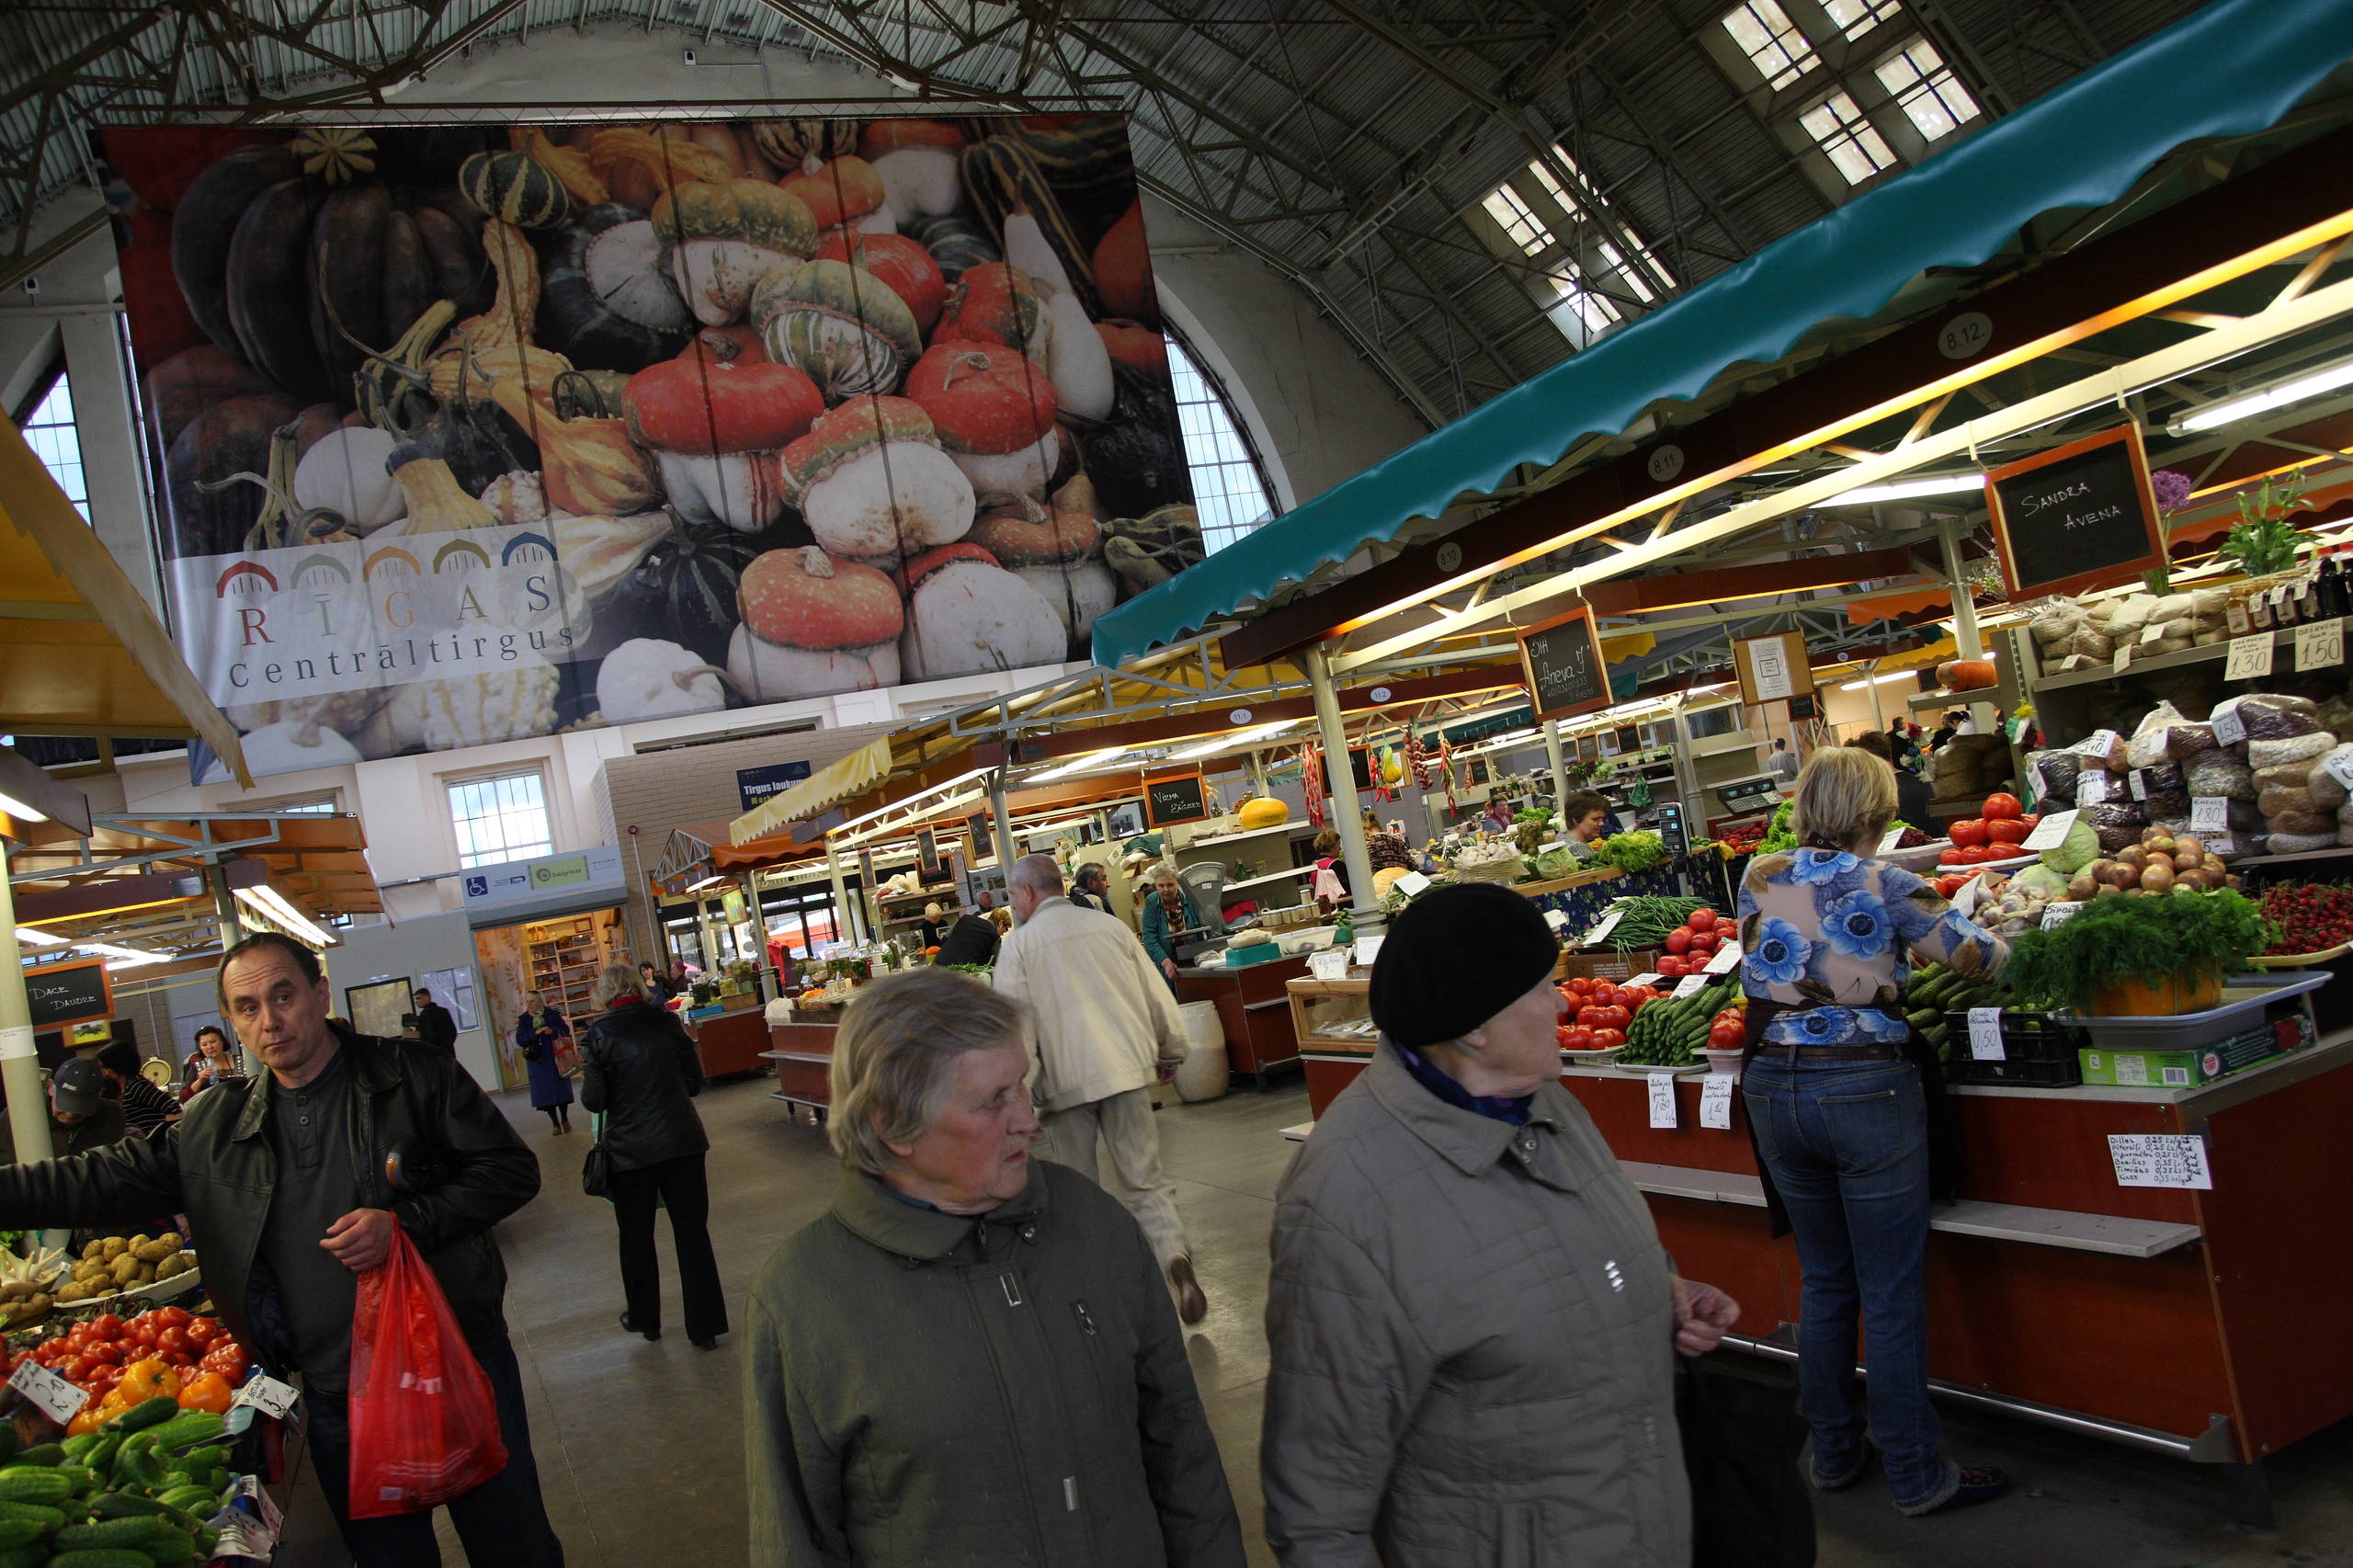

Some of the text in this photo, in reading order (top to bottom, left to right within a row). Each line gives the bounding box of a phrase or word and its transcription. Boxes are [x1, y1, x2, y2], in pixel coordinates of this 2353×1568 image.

[1947, 323, 1985, 350] 8.12.
[2022, 483, 2091, 517] SANDRA
[2064, 506, 2121, 529] AVENA
[236, 574, 551, 646] RĪGAS
[229, 624, 574, 688] Centrāltirgus
[744, 783, 771, 795] Tirgus
[29, 986, 69, 1000] DACE
